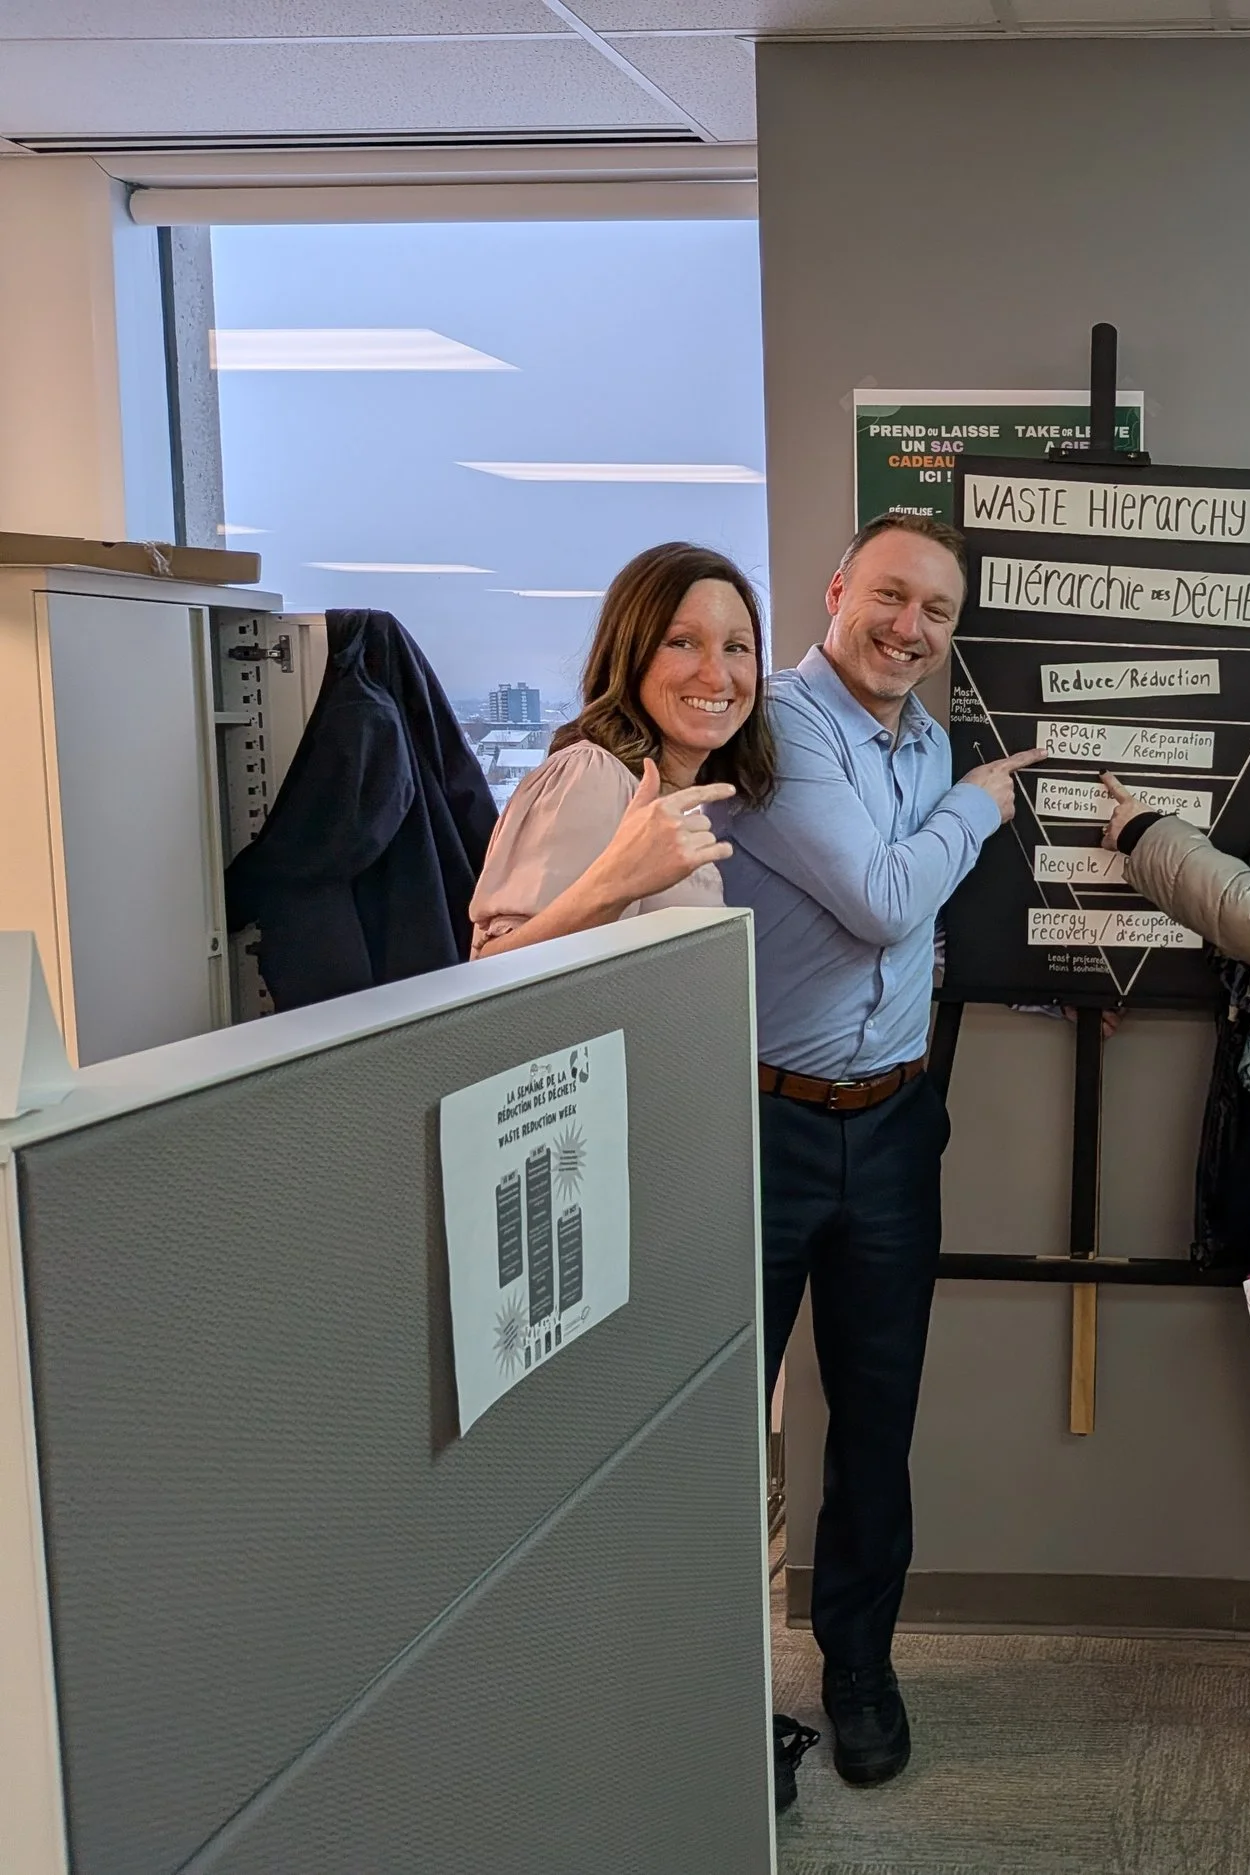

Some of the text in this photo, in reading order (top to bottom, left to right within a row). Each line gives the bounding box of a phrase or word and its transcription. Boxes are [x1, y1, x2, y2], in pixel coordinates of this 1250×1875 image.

[869, 425, 1000, 438] PREND OU LAISSE
[1014, 425, 1060, 438] TAKE
[1062, 428, 1073, 437] OR
[901, 440, 964, 453] UN SAC
[888, 455, 955, 468] CADEAU
[920, 470, 942, 483] ICI
[973, 484, 1068, 526] WASTE
[988, 561, 1144, 611] Hiérarchie
[1151, 588, 1171, 601] DES
[953, 686, 975, 697] Most
[1046, 739, 1102, 757] Reuse
[1043, 797, 1098, 813] Refurbish
[1139, 790, 1188, 809] Remise
[1039, 853, 1099, 880] Recycle
[1032, 912, 1086, 931] energy
[1031, 926, 1098, 944] recovery
[1047, 953, 1070, 963] Least
[506, 1090, 516, 1105] LA
[546, 1073, 555, 1088] DE
[557, 1070, 567, 1083] LA
[533, 1091, 546, 1108] DES
[548, 1079, 577, 1103] DÉCHETS
[498, 1127, 520, 1149] WASTE
[559, 1104, 577, 1120] WEEK
